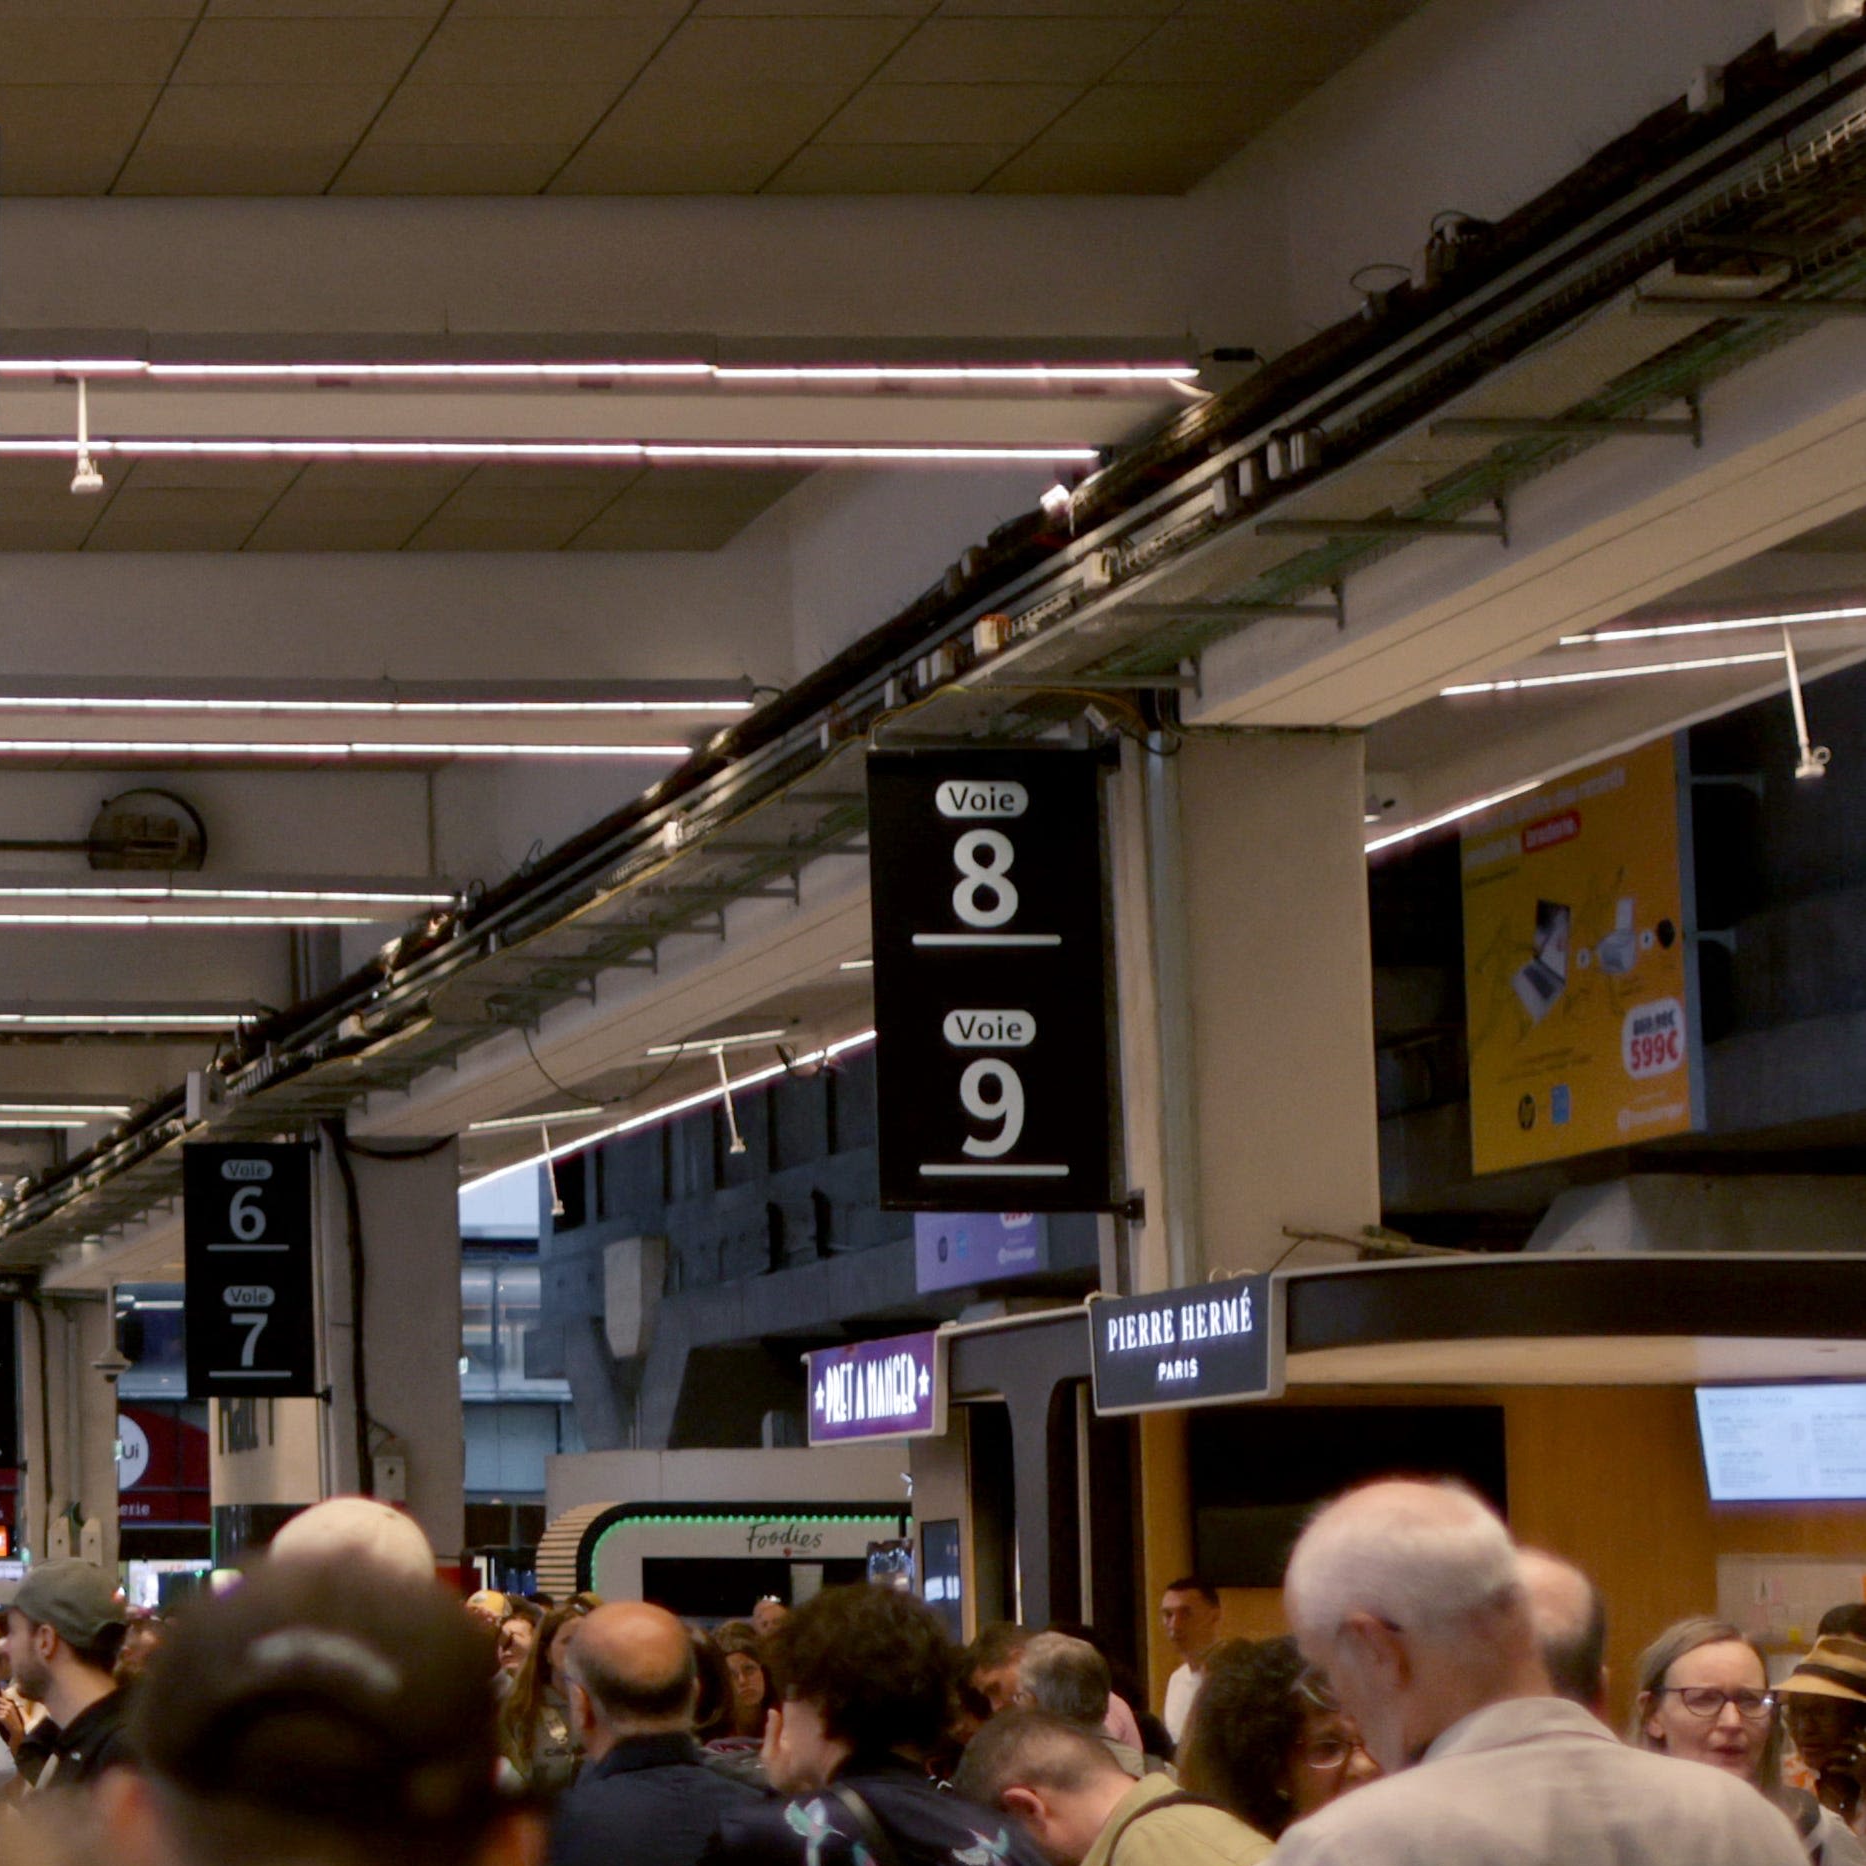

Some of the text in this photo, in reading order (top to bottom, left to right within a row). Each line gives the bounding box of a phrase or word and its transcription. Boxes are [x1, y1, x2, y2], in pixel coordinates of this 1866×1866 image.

[947, 787, 1016, 814] Voie
[952, 829, 1020, 928] 8
[955, 1015, 1023, 1043] Voie
[960, 1057, 1025, 1158] 9
[228, 1161, 267, 1178] Voie
[229, 1186, 266, 1242] 6
[230, 1287, 268, 1304] Voie
[230, 1312, 269, 1367] 7
[1108, 1287, 1252, 1353] PIERRE HERMÉ
[826, 1353, 917, 1424] PRET A MANGER
[1158, 1358, 1198, 1381] PARIS
[747, 1522, 824, 1553] Foodies
